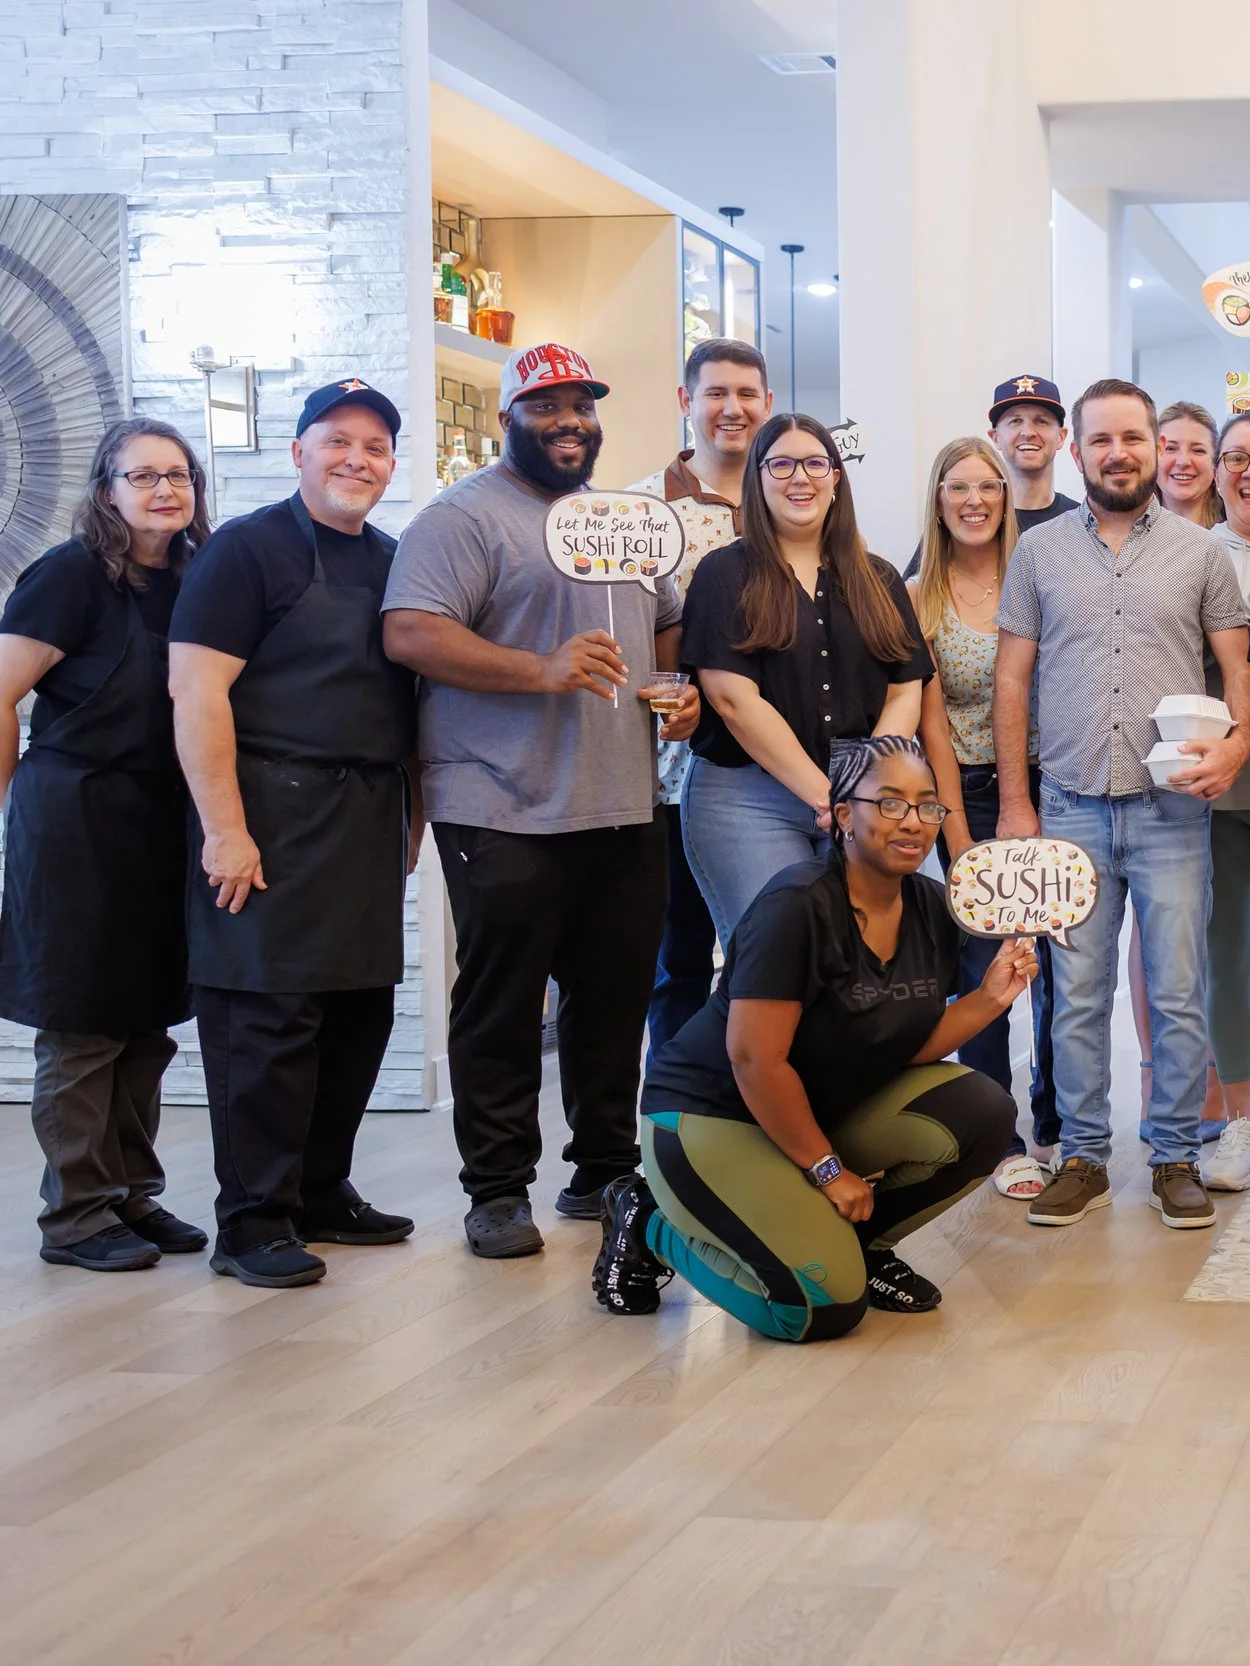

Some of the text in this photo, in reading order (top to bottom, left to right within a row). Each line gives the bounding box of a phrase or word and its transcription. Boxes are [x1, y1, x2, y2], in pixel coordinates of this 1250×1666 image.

[556, 517, 670, 534] Let Me See That
[622, 536, 668, 558] ROLL
[1003, 846, 1043, 866] Talk
[998, 906, 1050, 924] To Me
[852, 979, 938, 1002] SPYDER
[607, 1262, 620, 1290] JUST
[868, 1277, 913, 1304] JUST SO
